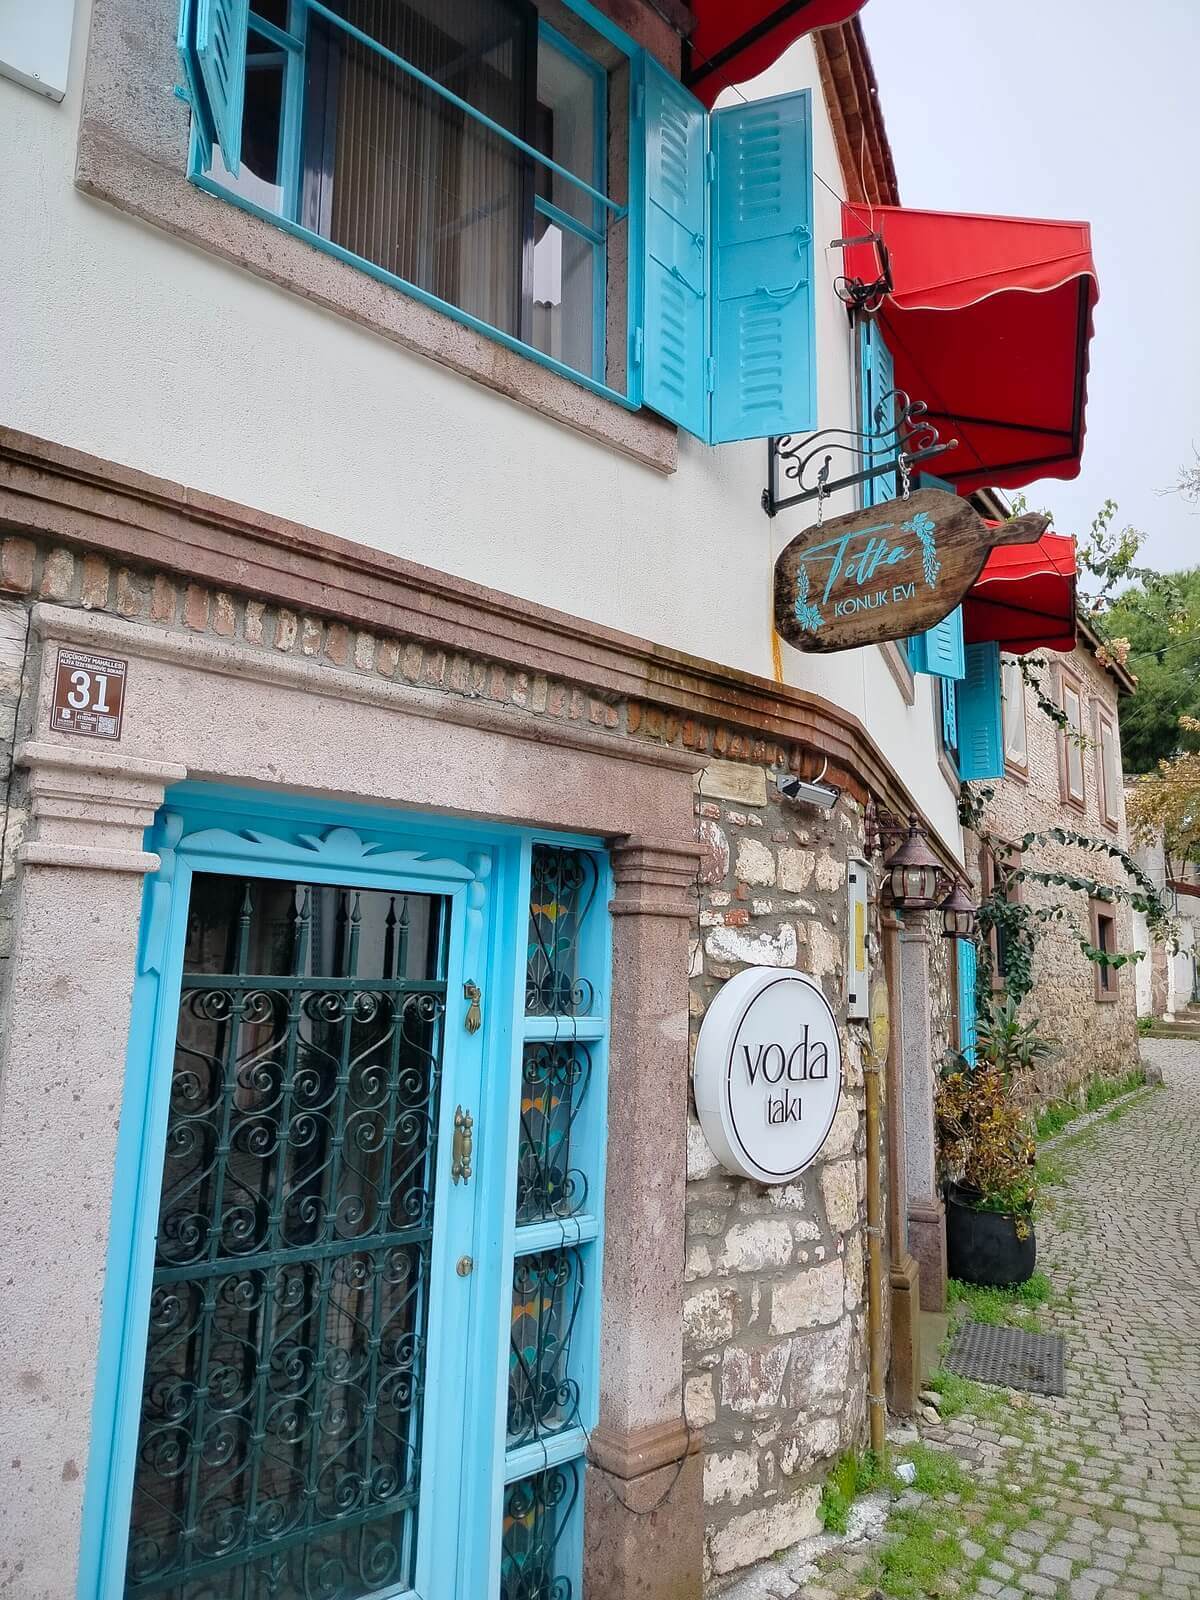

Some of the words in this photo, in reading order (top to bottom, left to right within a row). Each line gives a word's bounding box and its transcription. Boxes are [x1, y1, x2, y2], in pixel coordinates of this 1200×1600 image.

[800, 521, 914, 604] Tetka
[834, 590, 888, 617] KONUK
[68, 670, 110, 712] 31
[743, 1025, 828, 1085] voda
